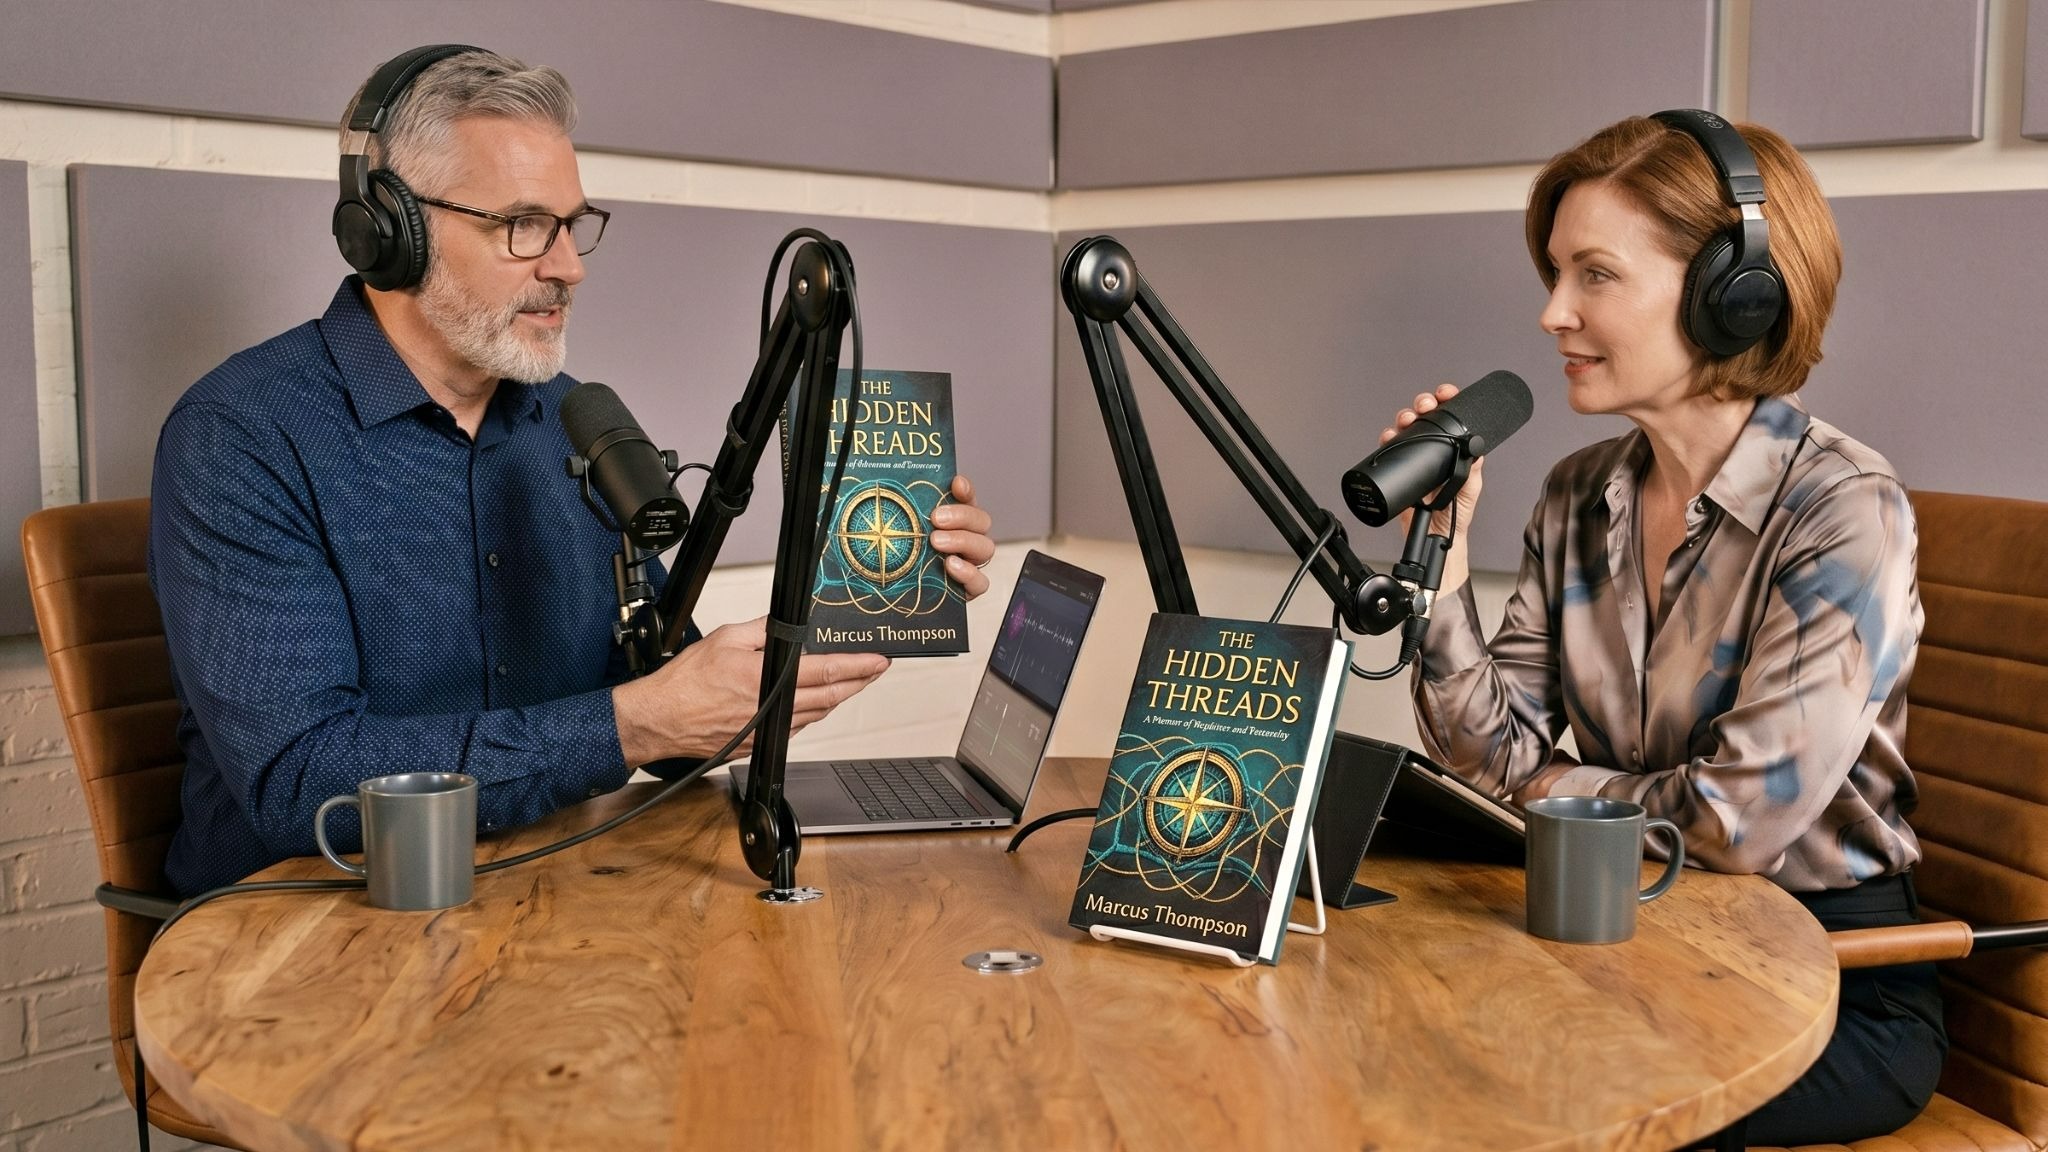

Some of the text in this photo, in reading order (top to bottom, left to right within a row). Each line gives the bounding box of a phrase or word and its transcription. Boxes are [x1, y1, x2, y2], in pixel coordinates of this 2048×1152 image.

[860, 380, 892, 395] THE
[829, 429, 943, 456] HREADS
[816, 625, 956, 645] Marcus Thompson
[1219, 630, 1255, 649] THE
[1163, 649, 1300, 688] HIDDEN
[1147, 680, 1302, 724] THREADS
[1143, 715, 1151, 724] A
[1183, 718, 1194, 730] of
[1231, 726, 1248, 734] and
[1085, 893, 1248, 938] Marcus Thompson
